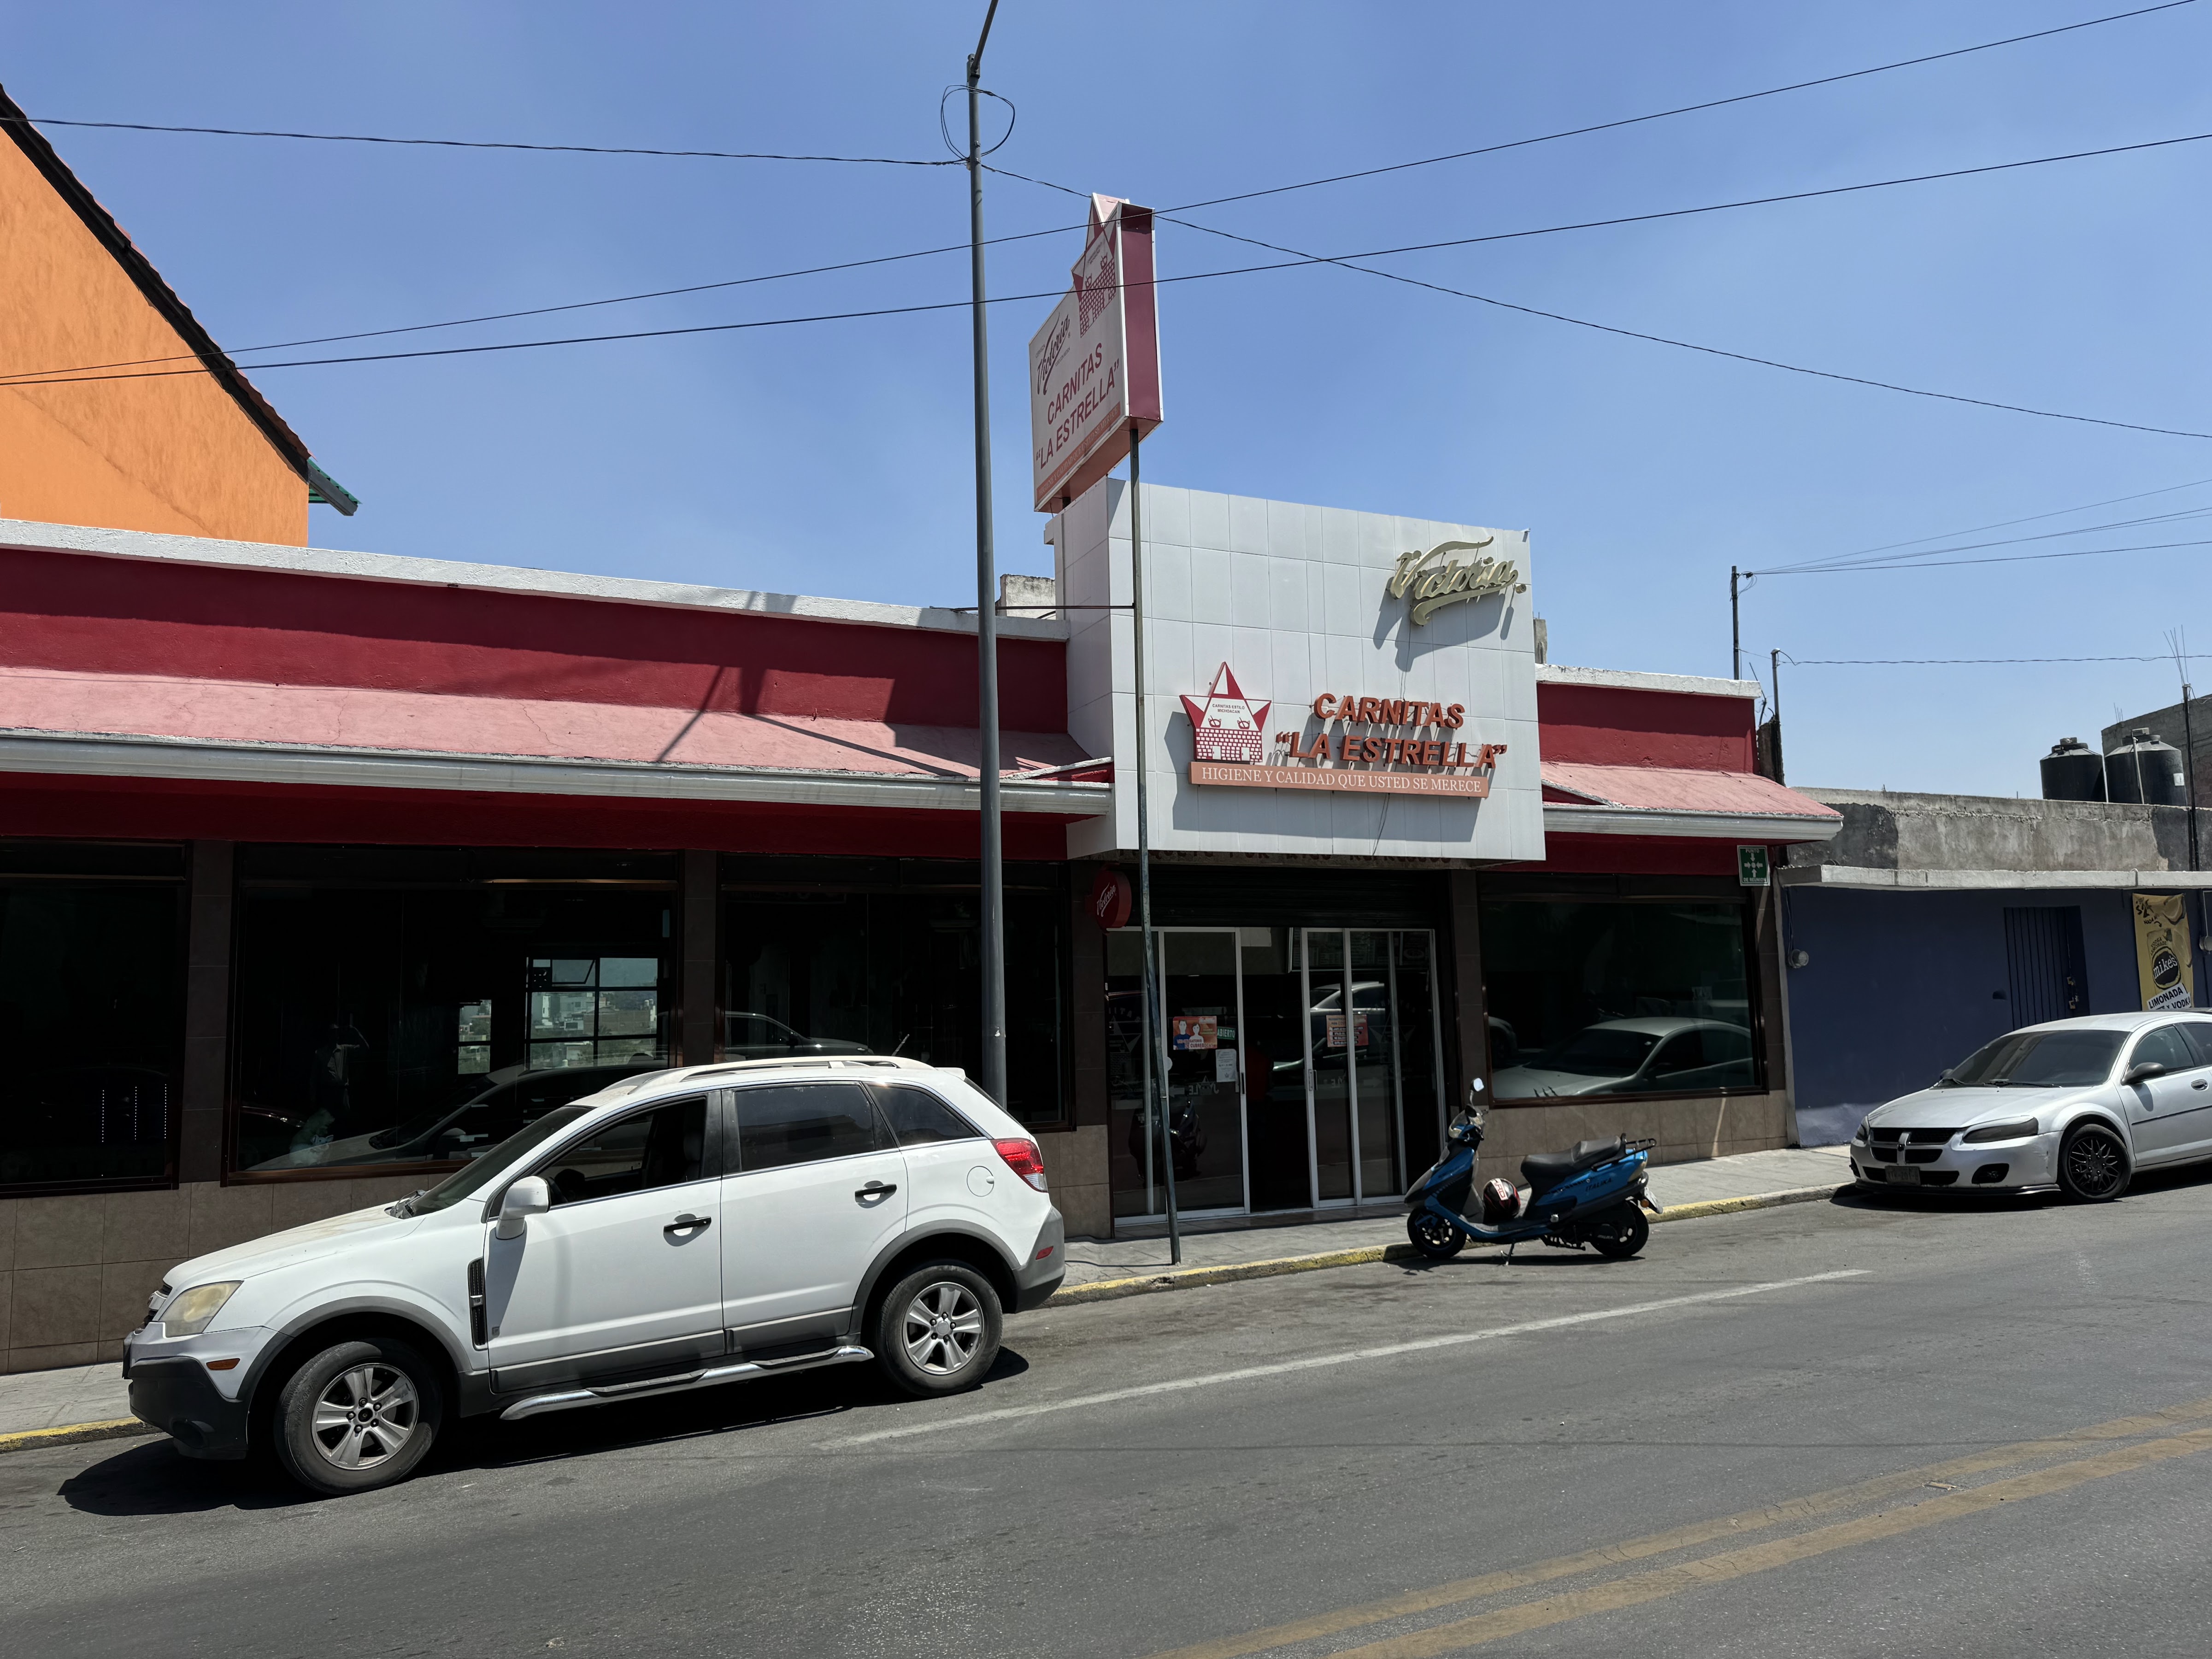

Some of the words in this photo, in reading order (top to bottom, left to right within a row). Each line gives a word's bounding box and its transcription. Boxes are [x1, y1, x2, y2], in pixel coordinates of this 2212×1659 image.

[1037, 312, 1070, 395] Victoria
[1047, 342, 1102, 425] CARNITAS
[1036, 438, 1053, 470] “LA
[1056, 358, 1119, 452] ESTRELLA”
[1390, 536, 1518, 625] Victoria
[1314, 693, 1465, 729] CARNITAS
[1276, 731, 1331, 759] “LA
[1340, 735, 1507, 769] ESTRELLA”
[1201, 767, 1262, 781] HIGIENE
[1265, 770, 1274, 782] Y
[1276, 771, 1335, 786] CALIDAD
[1337, 774, 1366, 789] QUE
[1369, 775, 1410, 789] USTED
[1413, 777, 1429, 790] SE
[1430, 779, 1482, 793] MERECE
[1096, 881, 1116, 918] Victoria
[2153, 956, 2178, 979] mike's
[2148, 987, 2183, 1009] LIMONADA
[1217, 1028, 1235, 1038] ABIERTO
[1585, 1177, 1612, 1192] ITALIKA
